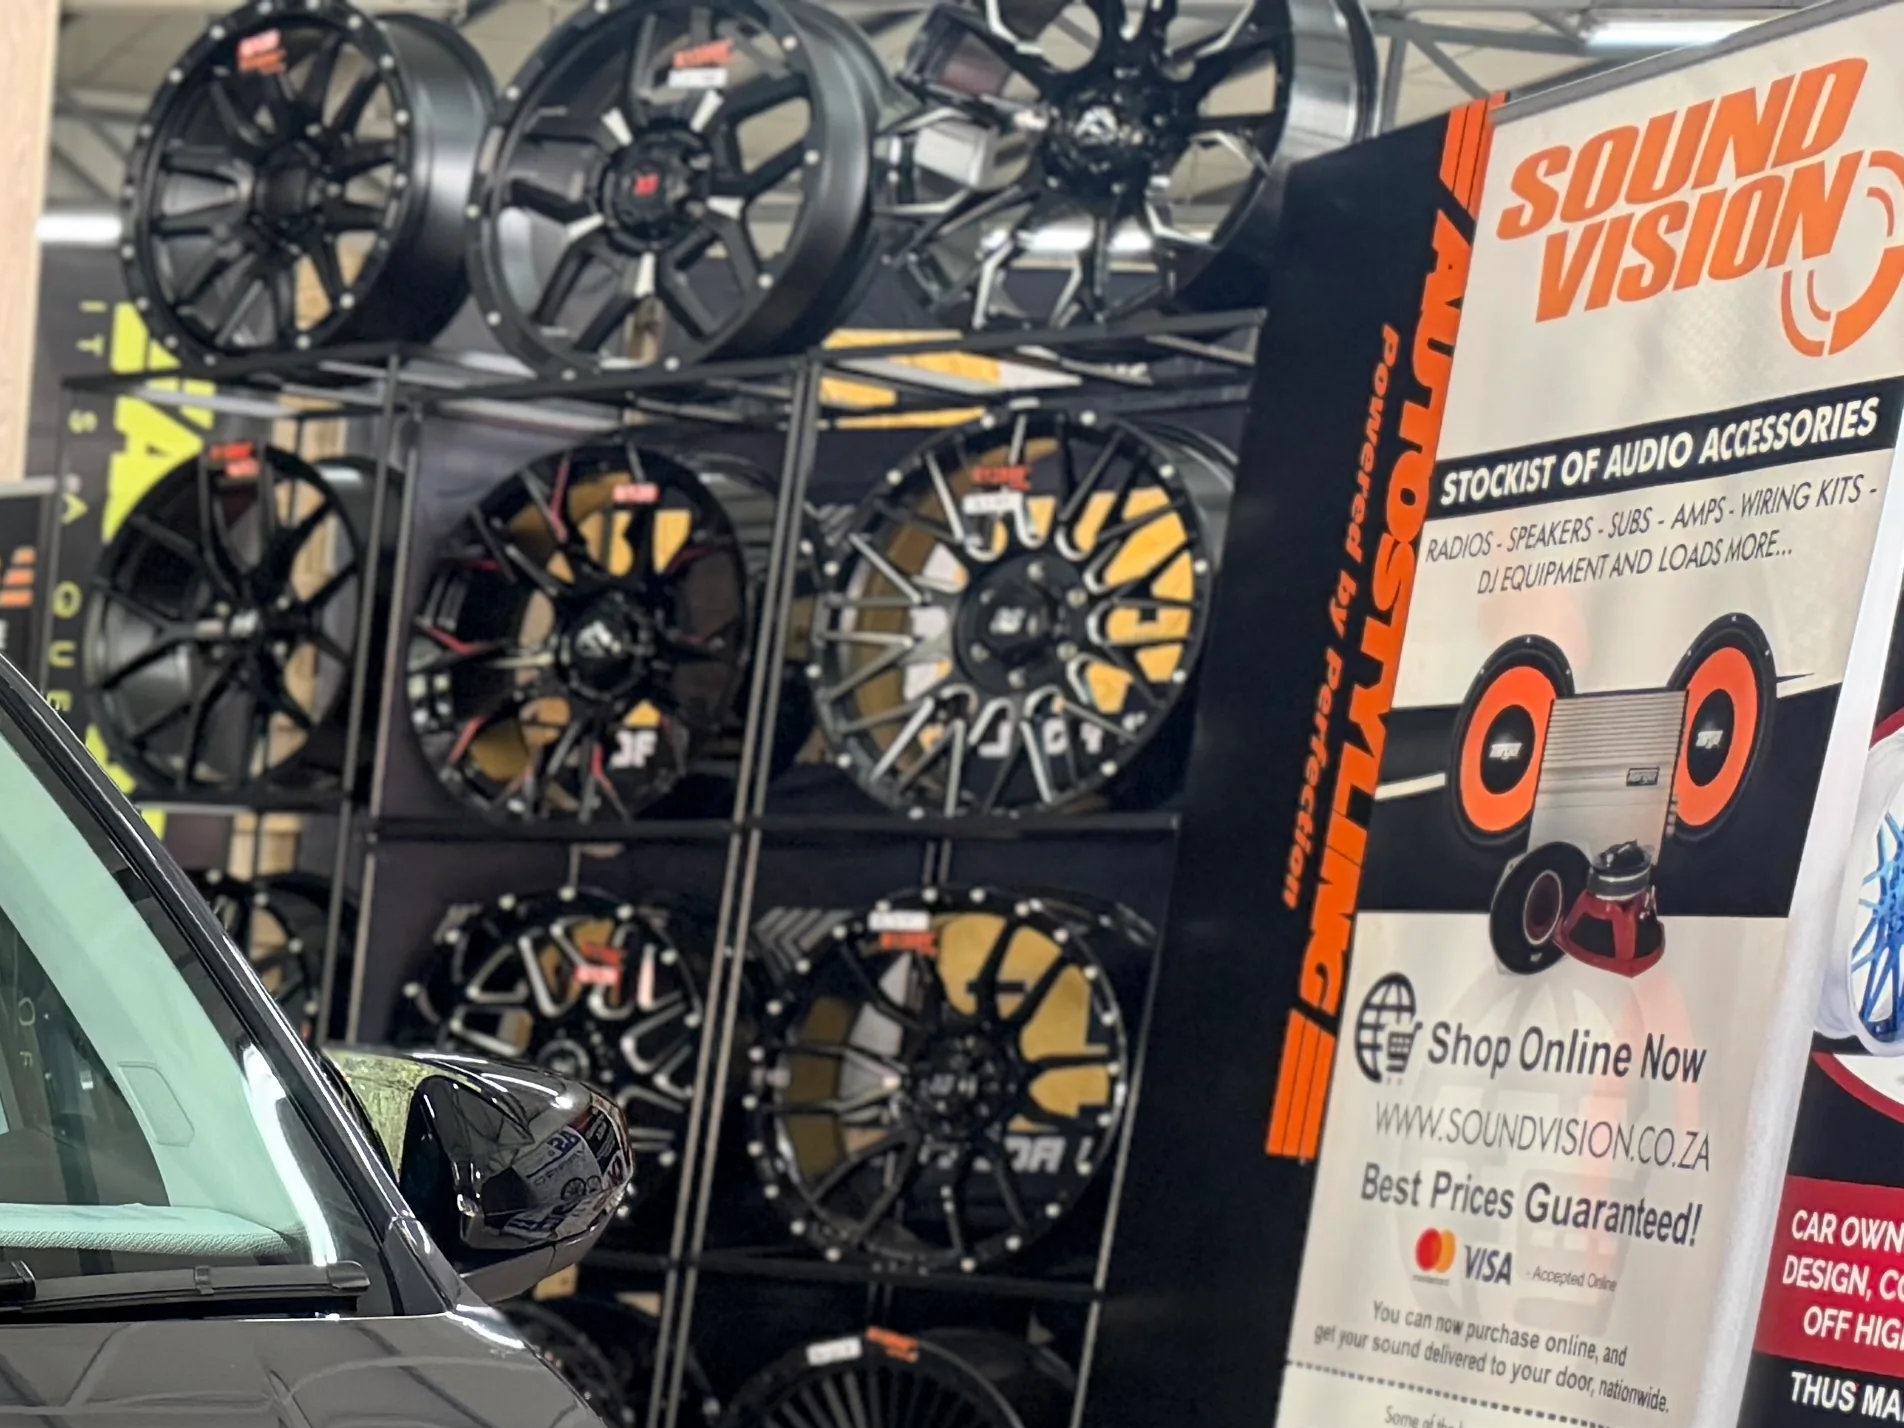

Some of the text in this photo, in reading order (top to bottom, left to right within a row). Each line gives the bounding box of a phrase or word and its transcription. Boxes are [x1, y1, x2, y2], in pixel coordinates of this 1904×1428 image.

[1496, 57, 1868, 241] SOUND
[1534, 149, 1865, 323] VISION
[1440, 396, 1880, 507] STOCKIST OF AUDIO ACCESSORIES
[1425, 530, 1494, 564] RADIOS
[1507, 515, 1594, 553] SPEAKERS
[1607, 506, 1653, 540] SUBS
[1671, 495, 1726, 530] AMPS
[1741, 481, 1812, 519] WIRING
[1816, 473, 1865, 508] KITS
[1477, 529, 1793, 596] DJ EQUIPMENT AND LOADS MORE...
[1329, 568, 1358, 638] by
[1428, 1021, 1707, 1084] Shop Online Now
[1375, 1101, 1711, 1173] WWW.SOUNDVISION.CO.ZA
[1361, 1161, 1703, 1248] Best Prices Guaranteed!
[1792, 1209, 1838, 1245] CAR
[1464, 1245, 1513, 1286] VISA
[1532, 1265, 1585, 1288] Accepted
[1587, 1273, 1618, 1293] Online
[1782, 1254, 1873, 1302] DESIGN,
[1372, 1300, 1628, 1367] You can now purchase online, and
[1803, 1306, 1853, 1341] OFF
[1313, 1323, 1670, 1414] get your sound delivered to your door, nationwide.
[1791, 1371, 1857, 1412] THUS
